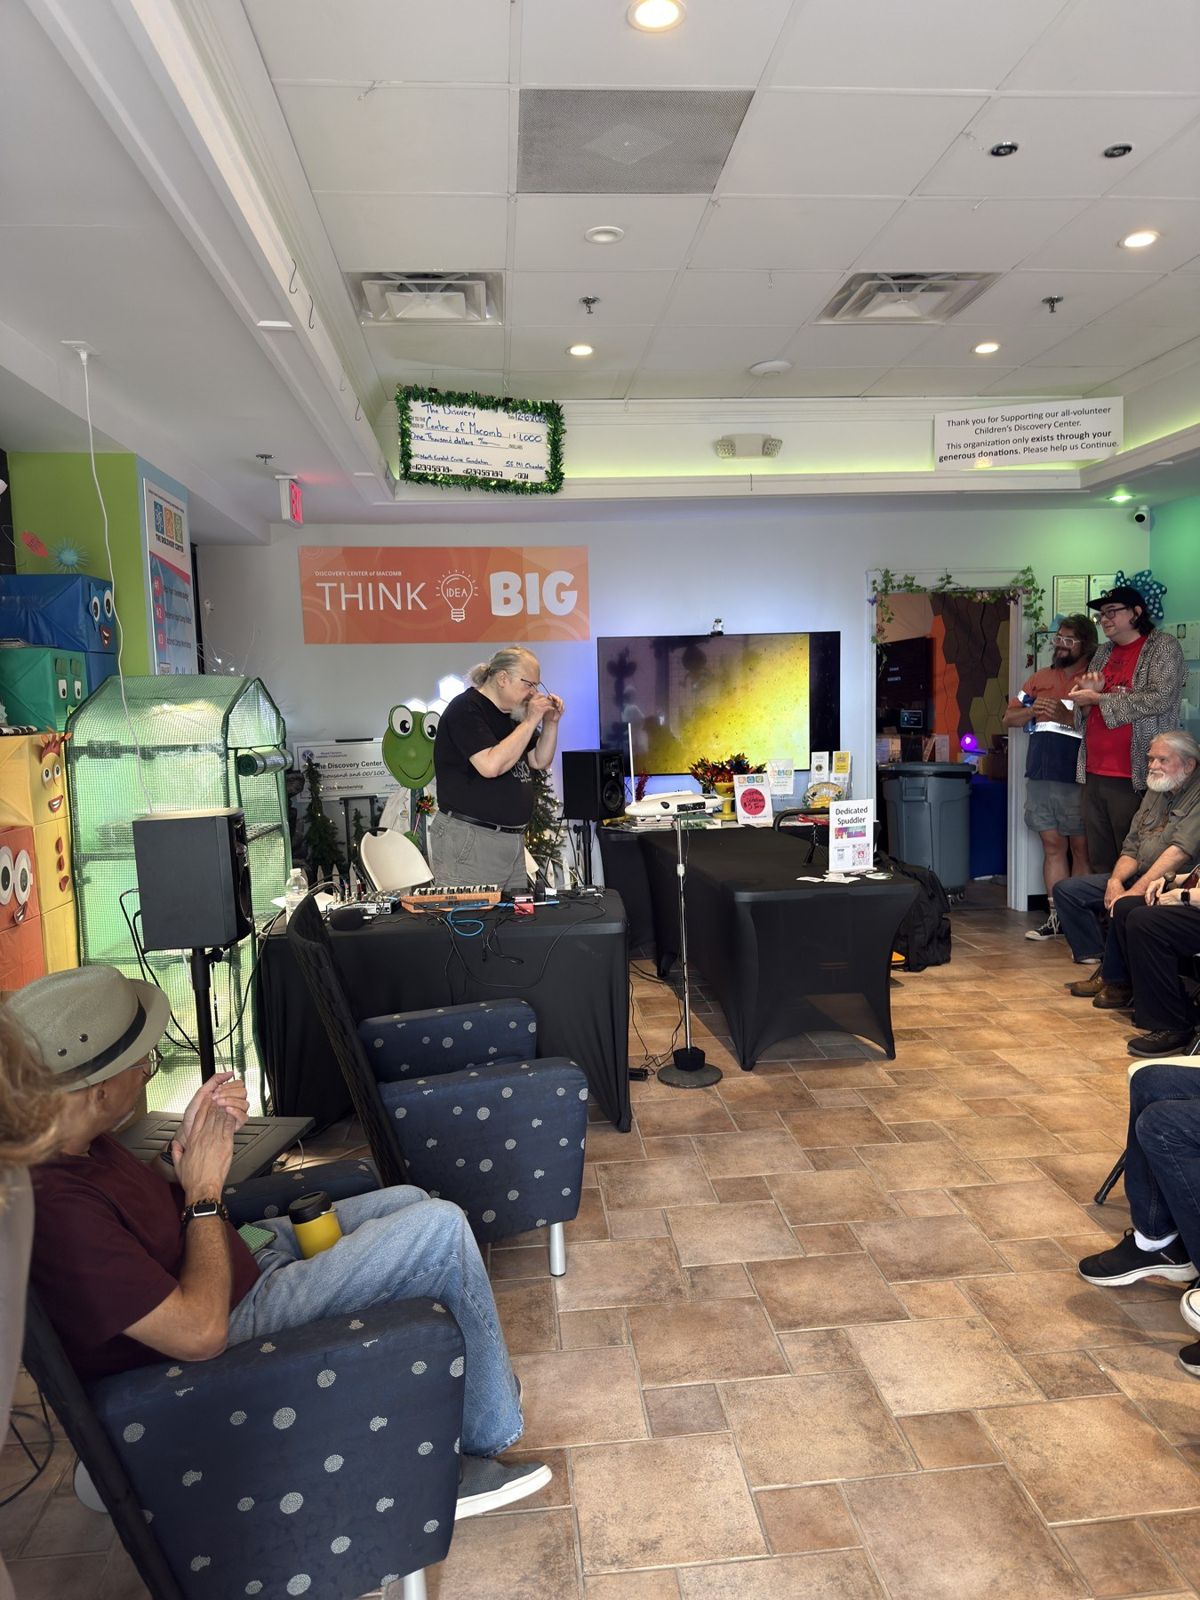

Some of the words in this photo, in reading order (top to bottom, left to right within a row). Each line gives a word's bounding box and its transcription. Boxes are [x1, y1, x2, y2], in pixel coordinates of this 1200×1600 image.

[421, 403, 439, 414] The
[947, 418, 970, 427] Thank
[971, 417, 985, 426] you
[1001, 412, 1043, 422] Supporting
[1061, 407, 1111, 417] all-volunteer
[426, 416, 449, 431] Center
[455, 421, 465, 432] of
[469, 421, 502, 438] Macomb
[974, 425, 1012, 435] Children's
[1014, 422, 1052, 432] Discovery
[1054, 420, 1082, 428] Center.
[454, 436, 474, 445] dollars
[947, 442, 961, 450] This
[963, 438, 1010, 449] organization
[1012, 436, 1029, 444] only
[1031, 434, 1054, 443] exists
[1056, 431, 1089, 440] through
[1092, 430, 1112, 439] your
[939, 452, 975, 462] generous
[978, 448, 1020, 457] donations.
[1050, 444, 1067, 452] help
[1080, 440, 1119, 449] Continue.
[316, 581, 428, 611] THINK
[446, 588, 468, 598] IDEA
[489, 570, 578, 617] BIG
[328, 761, 360, 769] Discovery
[360, 760, 383, 768] Center
[835, 806, 869, 815] Dedicated
[837, 817, 867, 826] Spuddler
